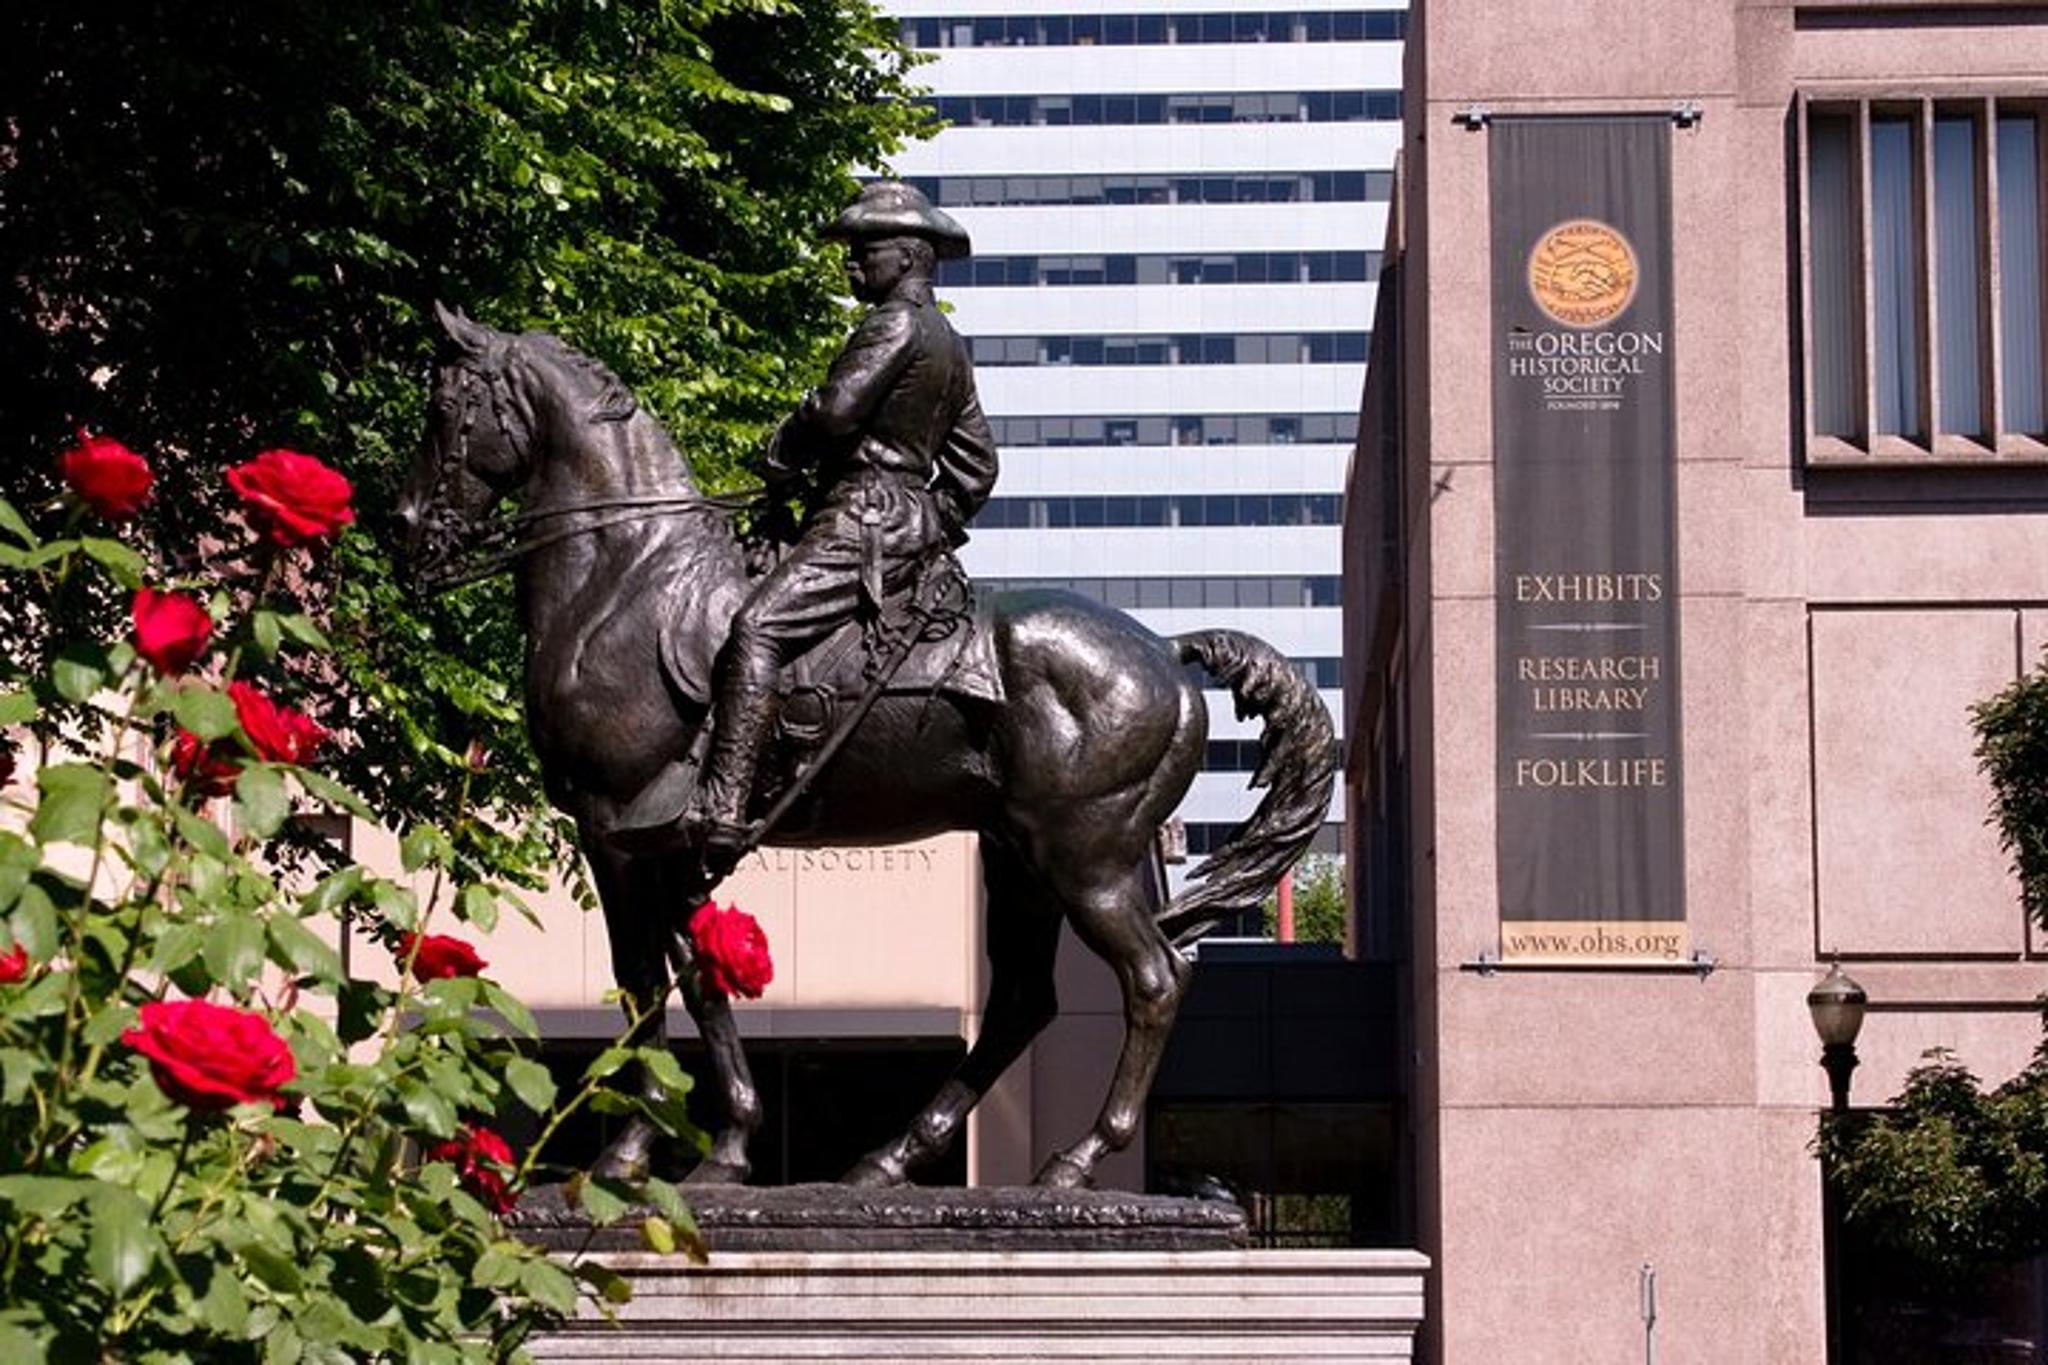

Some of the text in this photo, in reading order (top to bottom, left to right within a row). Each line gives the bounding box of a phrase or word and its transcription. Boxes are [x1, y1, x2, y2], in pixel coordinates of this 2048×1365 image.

[1509, 332, 1662, 356] THE OREGON
[1509, 357, 1643, 376] HISTORICAL
[1543, 376, 1624, 393] SOCIETY
[1516, 574, 1662, 601] EXHIBITS
[1518, 656, 1660, 680] RESEARCH
[1534, 687, 1648, 710] LIBRARY
[1517, 759, 1665, 786] FOLKLIFE
[801, 850, 937, 872] SOCIETY
[1510, 927, 1680, 962] www.ohs.org
